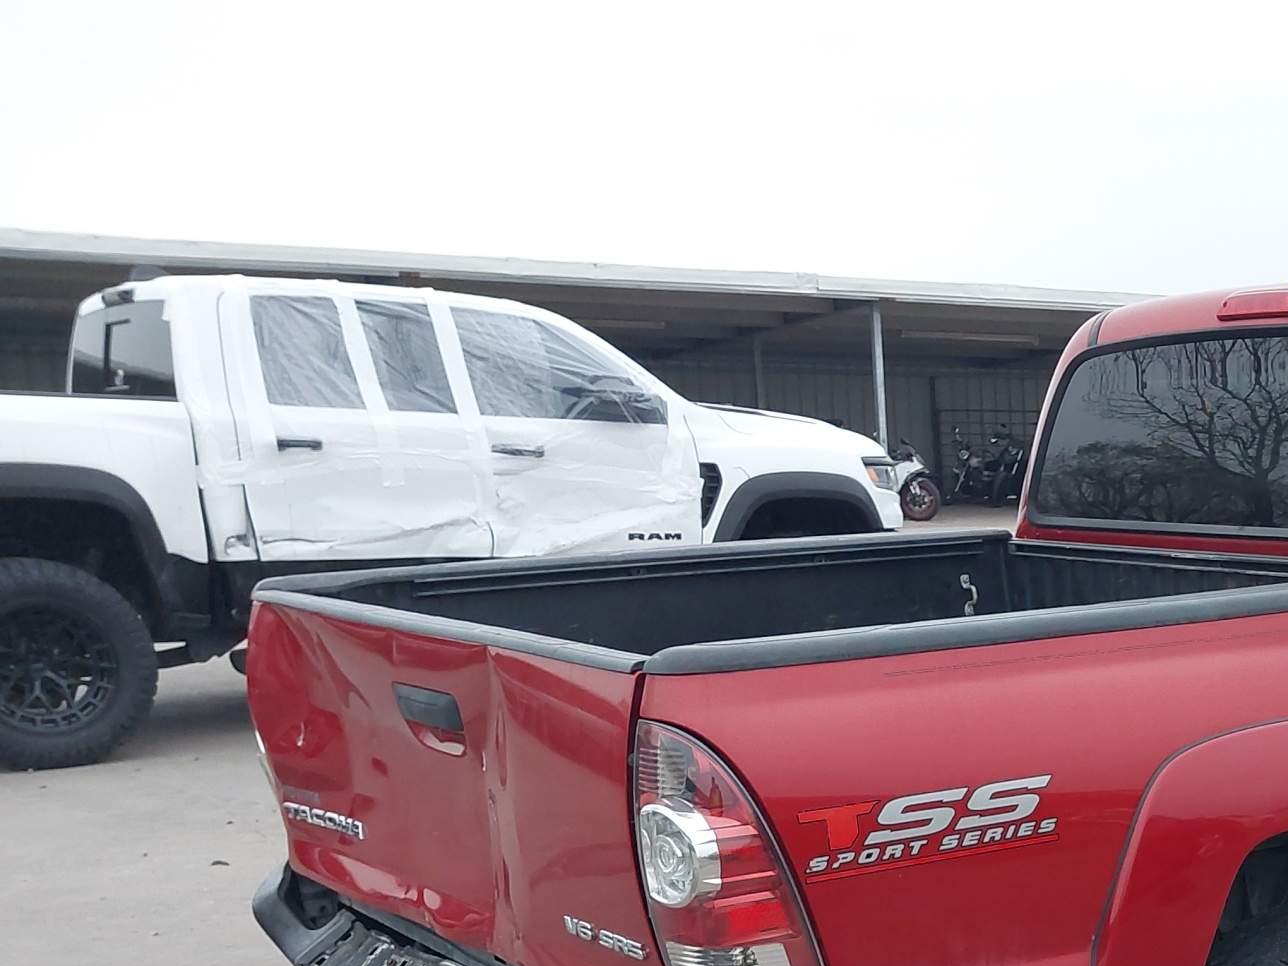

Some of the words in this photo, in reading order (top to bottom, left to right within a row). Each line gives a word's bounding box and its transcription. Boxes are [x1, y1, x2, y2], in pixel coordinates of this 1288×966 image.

[628, 532, 682, 541] RAM
[282, 801, 365, 840] TACOMA
[797, 774, 1052, 850] TSS
[805, 838, 929, 874] SPORT
[938, 817, 1059, 852] SERIES
[562, 914, 593, 941] V6
